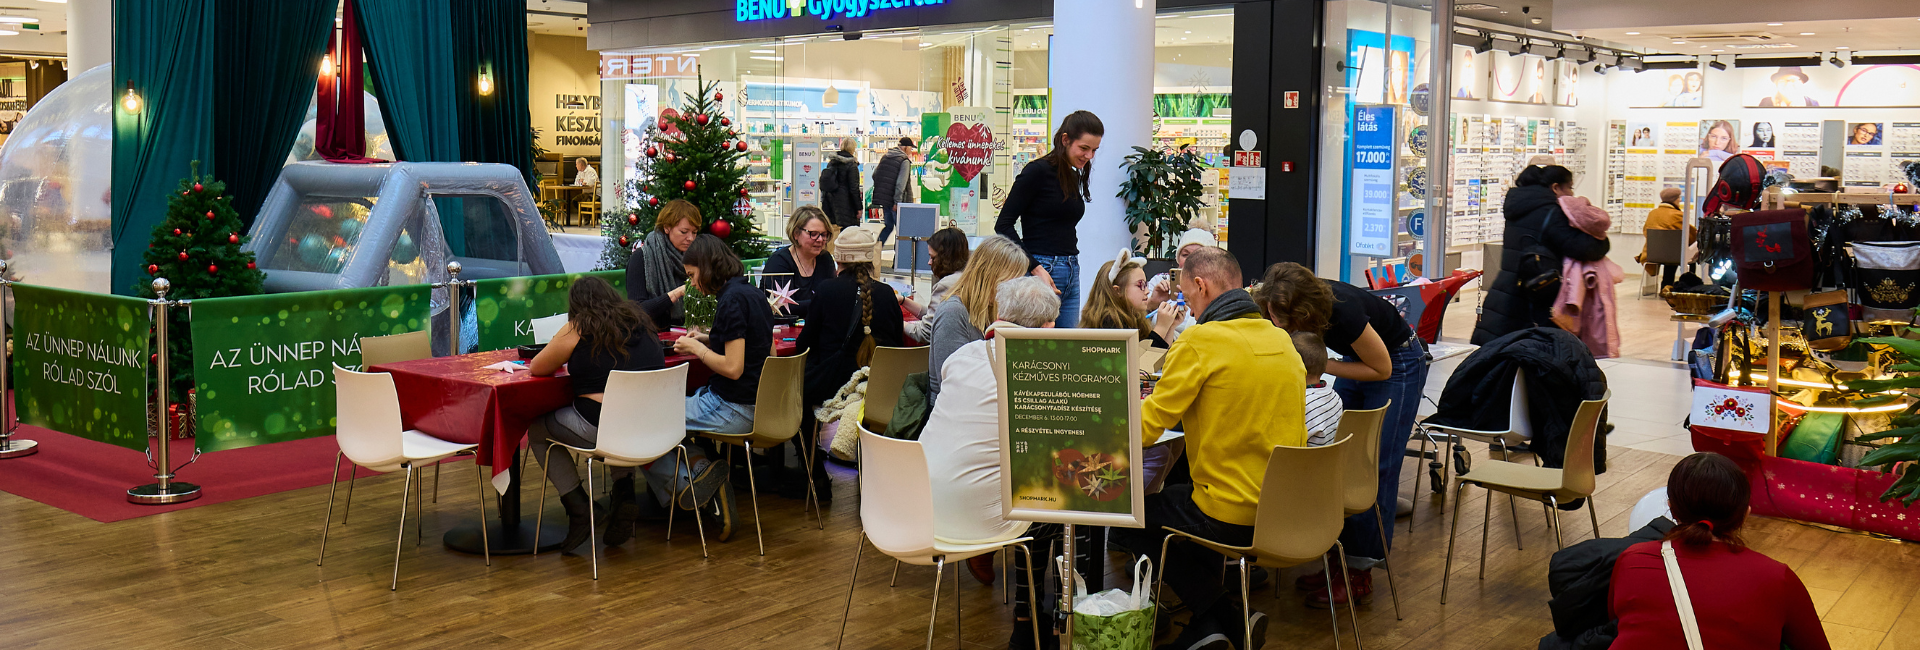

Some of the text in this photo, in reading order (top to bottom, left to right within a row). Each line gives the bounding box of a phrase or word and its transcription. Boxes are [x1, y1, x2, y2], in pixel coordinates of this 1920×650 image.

[737, 0, 944, 21] BENU Gyógysze
[954, 114, 977, 122] BENU
[1357, 110, 1375, 121] Éles
[1357, 121, 1378, 132] látás
[936, 136, 1006, 153] Kellemes ünnepeket
[947, 149, 993, 167] kívánunk!
[1356, 151, 1386, 163] 17.000
[1364, 190, 1387, 199] 39.000
[1364, 223, 1384, 232] 2.370
[26, 331, 142, 369] AZ ÜNNEP NÁLUNK
[209, 348, 242, 370] AZ
[250, 341, 325, 366] ÜNNEP
[1012, 360, 1070, 371] KARÁCSONYI
[43, 360, 122, 395] RÓLAD SZÓL
[248, 369, 325, 395] RÓLAD
[1012, 371, 1121, 384] KÉZMŰVES PROGRAMOK
[1013, 390, 1101, 399] KÁVÉKAPSZULÁBÓL HÓEMBER
[1071, 405, 1102, 414] KÉSZÍTÉSE
